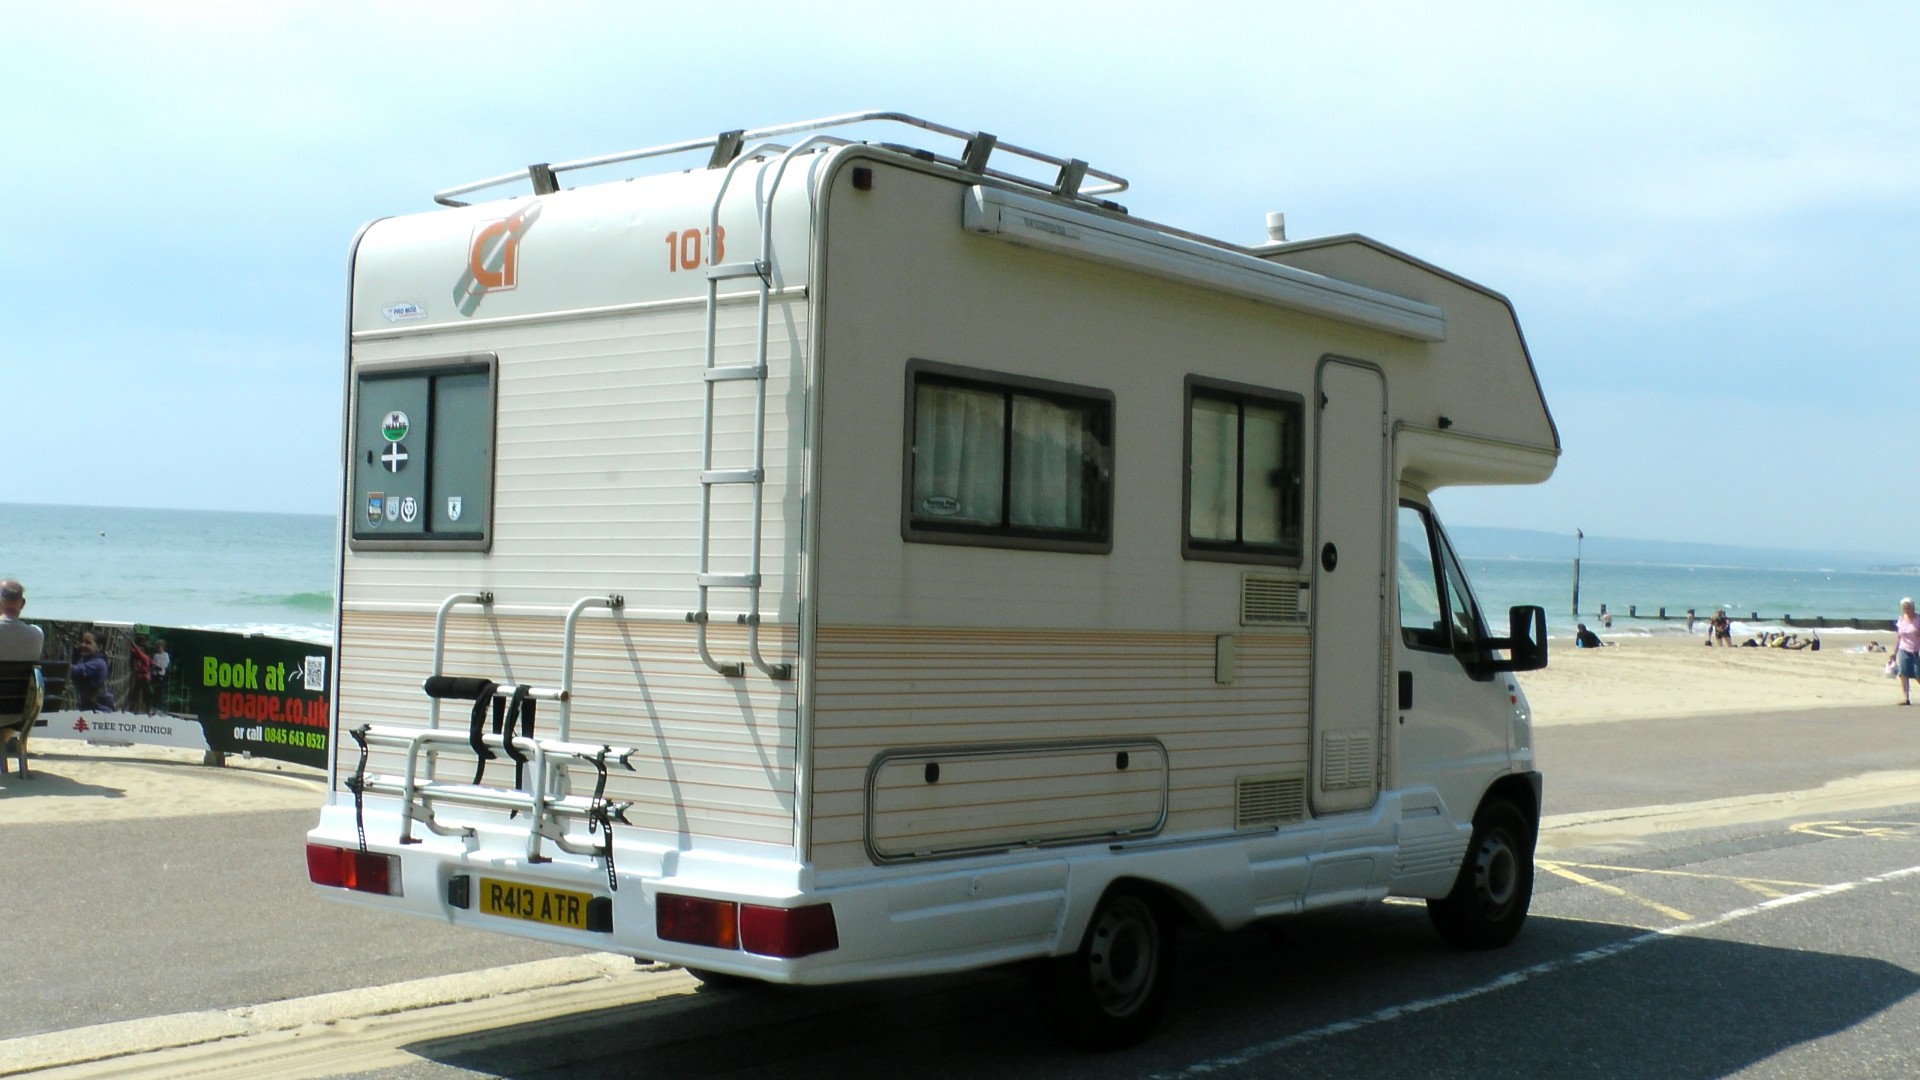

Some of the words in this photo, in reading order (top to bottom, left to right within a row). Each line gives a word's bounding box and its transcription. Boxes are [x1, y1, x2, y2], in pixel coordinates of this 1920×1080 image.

[665, 225, 725, 272] 103
[203, 656, 258, 689] Book
[265, 662, 285, 691] at
[218, 692, 328, 728] goape.co.uk
[92, 721, 116, 731] TREE
[118, 723, 136, 733] TOP
[139, 724, 173, 736] JUNIOR
[233, 726, 245, 740] or
[246, 725, 262, 742] call
[264, 727, 287, 745] 0845
[288, 730, 304, 747] 643
[306, 733, 326, 750] 0527
[491, 884, 534, 916] R413
[540, 892, 580, 924] ATR
